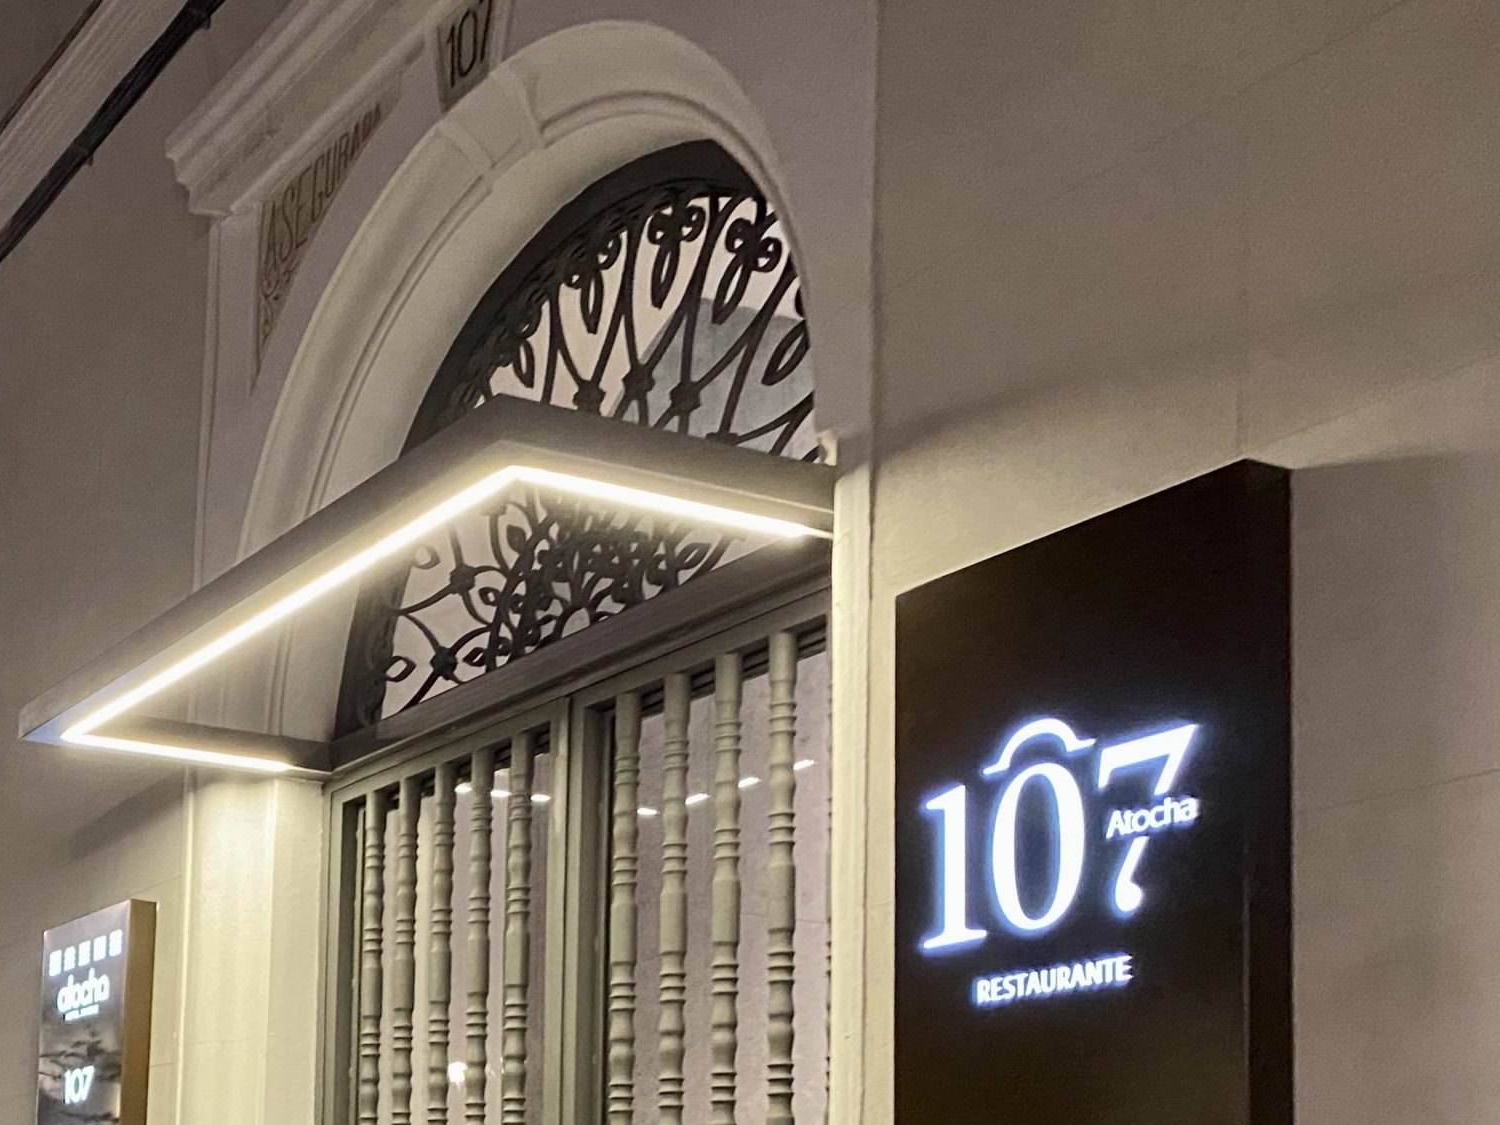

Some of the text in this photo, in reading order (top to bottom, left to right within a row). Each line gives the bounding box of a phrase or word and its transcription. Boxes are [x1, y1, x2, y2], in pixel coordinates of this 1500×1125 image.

[446, 0, 493, 88] 107
[920, 723, 1200, 950] 107
[1104, 794, 1199, 840] Atocha
[973, 953, 1133, 1006] RESTAURANTE
[63, 1065, 95, 1104] 107
